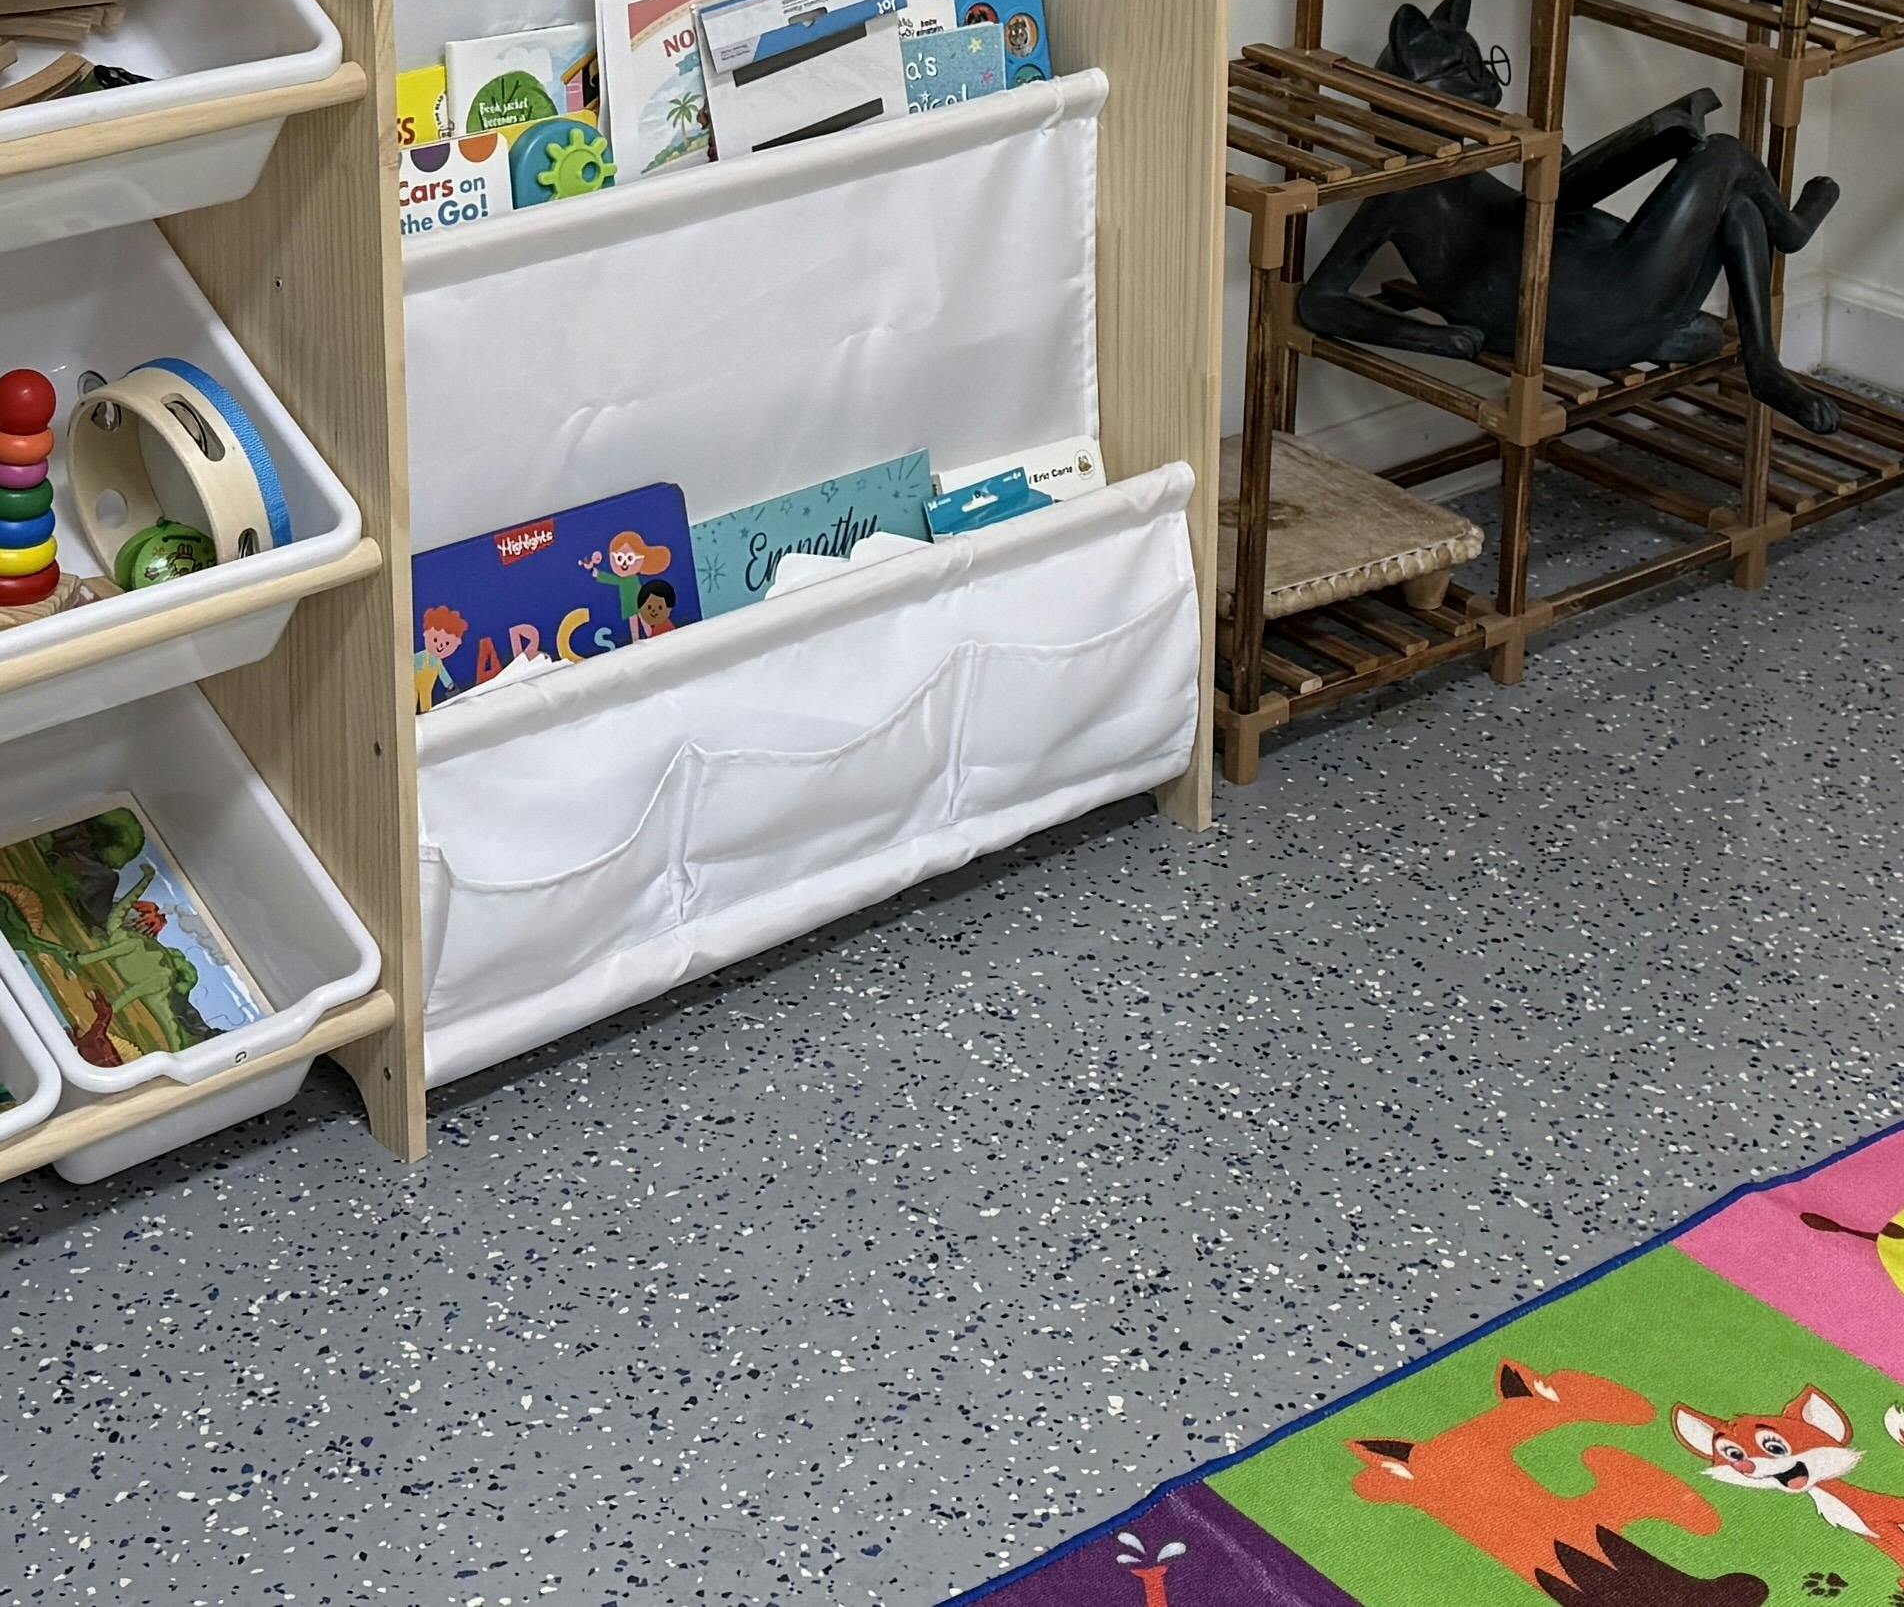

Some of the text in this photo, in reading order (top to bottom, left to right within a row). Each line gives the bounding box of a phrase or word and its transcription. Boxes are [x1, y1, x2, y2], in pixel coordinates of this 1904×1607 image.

[663, 26, 697, 58] NO
[399, 176, 486, 207] Cars on
[437, 193, 489, 227] Go!
[496, 529, 554, 558] Highlights
